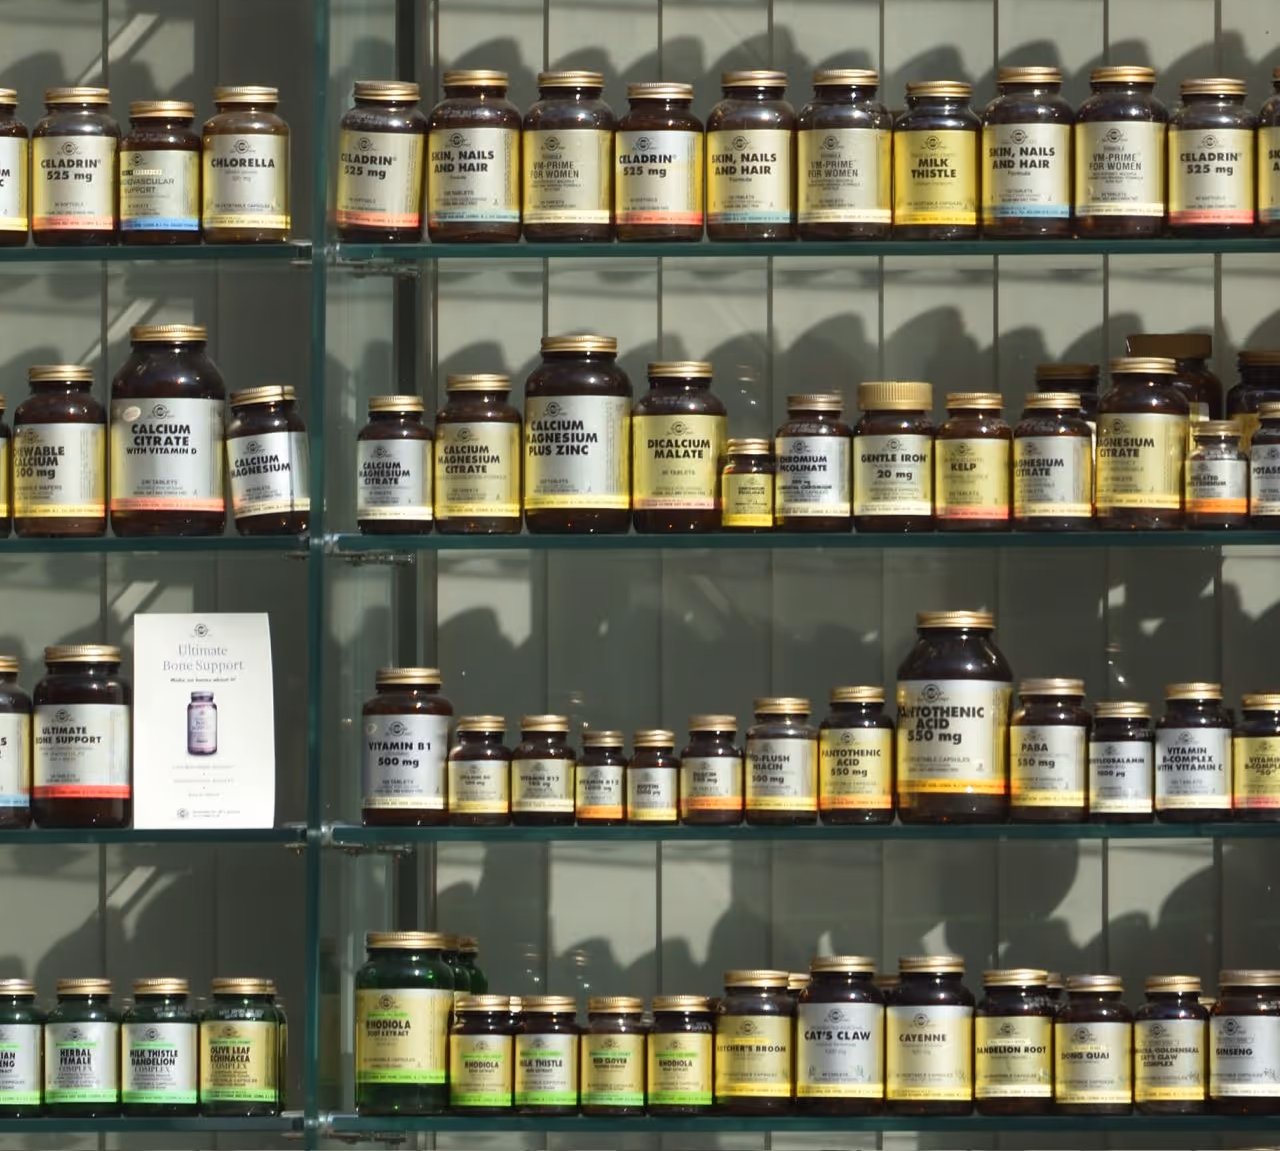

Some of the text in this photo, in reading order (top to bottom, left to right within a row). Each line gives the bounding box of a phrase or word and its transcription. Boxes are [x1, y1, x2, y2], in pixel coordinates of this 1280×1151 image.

[457, 151, 494, 160] NAILS
[1019, 146, 1055, 156] NAILS
[741, 153, 777, 162] NAILS
[210, 158, 275, 168] CHLORELLA
[460, 163, 488, 172] HAIR
[918, 159, 949, 168] MILK
[992, 159, 1050, 169] AND HAIR
[911, 169, 957, 178] THISTLE
[132, 424, 191, 435] CALCIUM
[134, 436, 190, 446] CITRATE
[647, 439, 711, 449] DICALCIUM
[126, 447, 190, 455] WITH VITAMIN
[444, 445, 489, 455] CALCIUM
[654, 449, 704, 459] MALATE
[901, 454, 927, 463] IRON
[445, 465, 487, 475] CITRATE
[951, 463, 977, 472] KELP
[877, 470, 892, 479] 20
[178, 643, 228, 657] Ultimate
[163, 660, 244, 674] Bone Support
[916, 718, 951, 730] ACID
[41, 726, 88, 736] ULTIMATE
[907, 730, 935, 742] 550
[55, 736, 102, 745] SUPPORT
[369, 741, 432, 752] VITAMIN B1
[1021, 742, 1049, 753] PABA
[1167, 747, 1208, 756] VITAMIN
[377, 757, 399, 767] 500
[837, 758, 860, 767] ACID
[831, 768, 851, 777] 550
[804, 1030, 872, 1041] CAT'S CLAW
[899, 1033, 947, 1043] CAYENNE
[1024, 1045, 1047, 1055] ROOT
